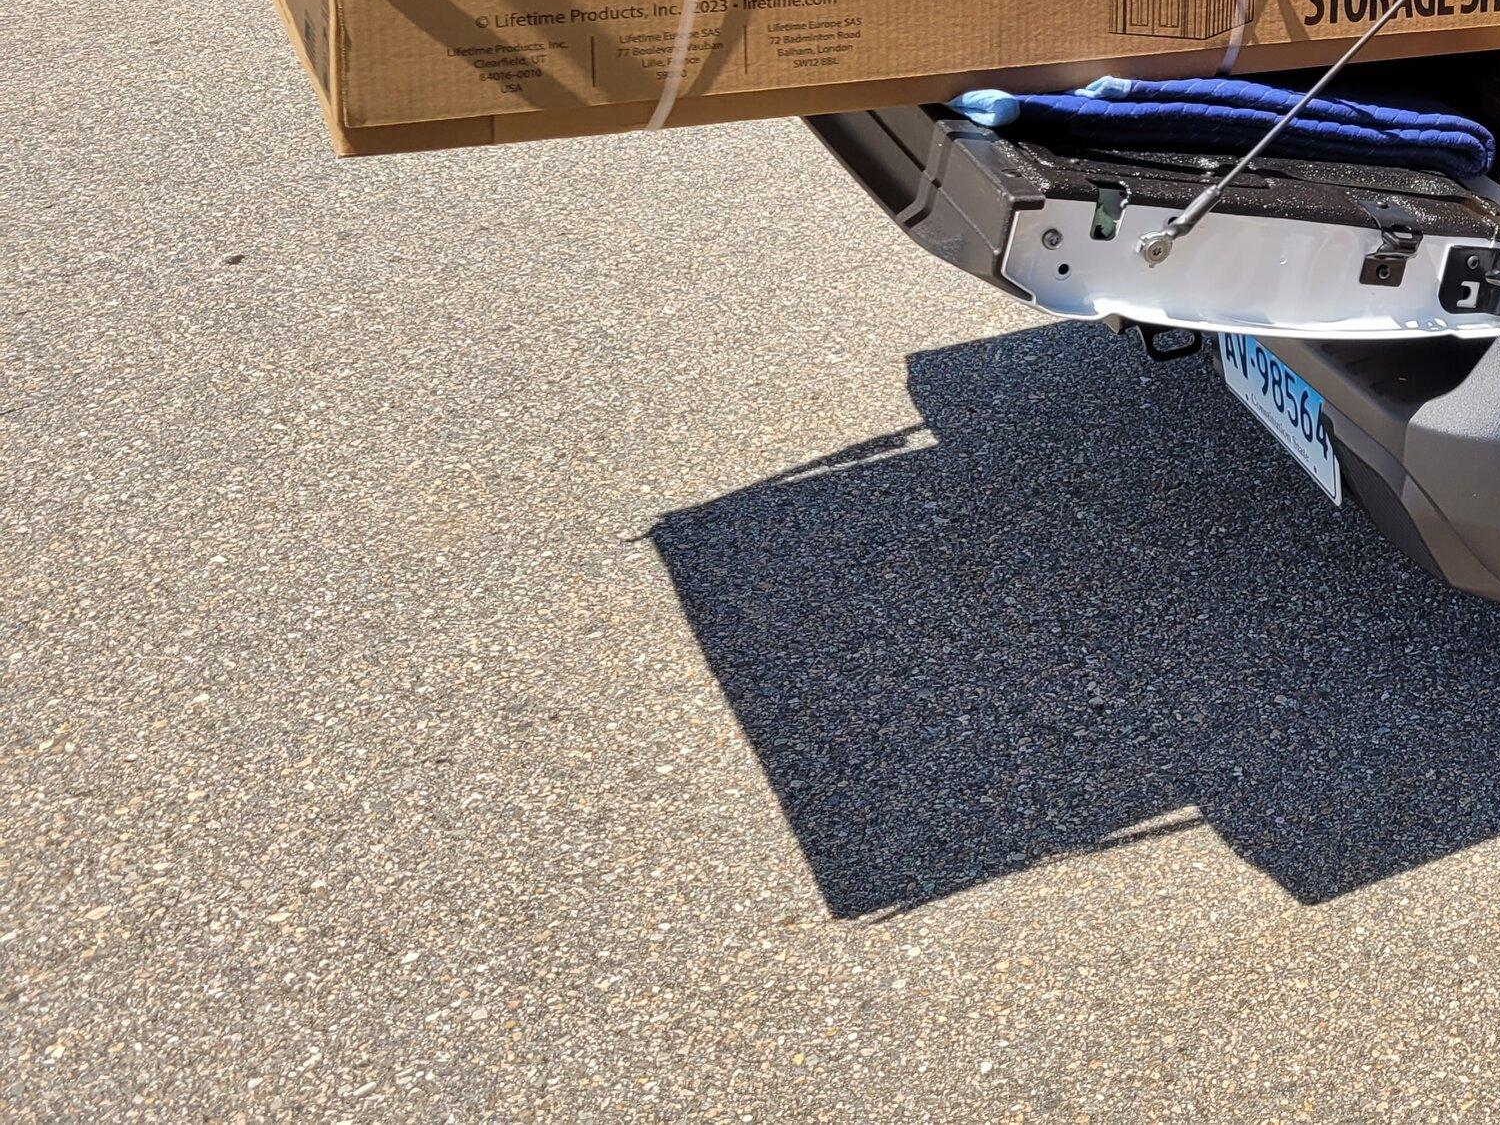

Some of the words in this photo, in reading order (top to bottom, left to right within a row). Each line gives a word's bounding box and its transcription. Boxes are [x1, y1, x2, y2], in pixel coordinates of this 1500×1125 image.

[495, 11, 566, 28] Lifetime
[570, 5, 649, 24] Products,
[652, 3, 682, 17] Inc.
[693, 0, 728, 14] 2023
[768, 22, 807, 32] Lifetime
[808, 19, 842, 30] Europe
[843, 17, 863, 27] SAS
[618, 33, 662, 44] Lifetime
[701, 27, 721, 37] SAS
[769, 35, 781, 45] 72
[783, 33, 836, 44] Badminton
[837, 30, 861, 40] Road
[447, 46, 494, 57] Lifetime
[549, 40, 569, 49] Inc.
[616, 47, 631, 57] 77
[817, 43, 854, 54] London
[531, 54, 547, 64] UT
[793, 57, 819, 69] SW12
[479, 69, 543, 82] 84016-0010
[501, 83, 523, 94] USA
